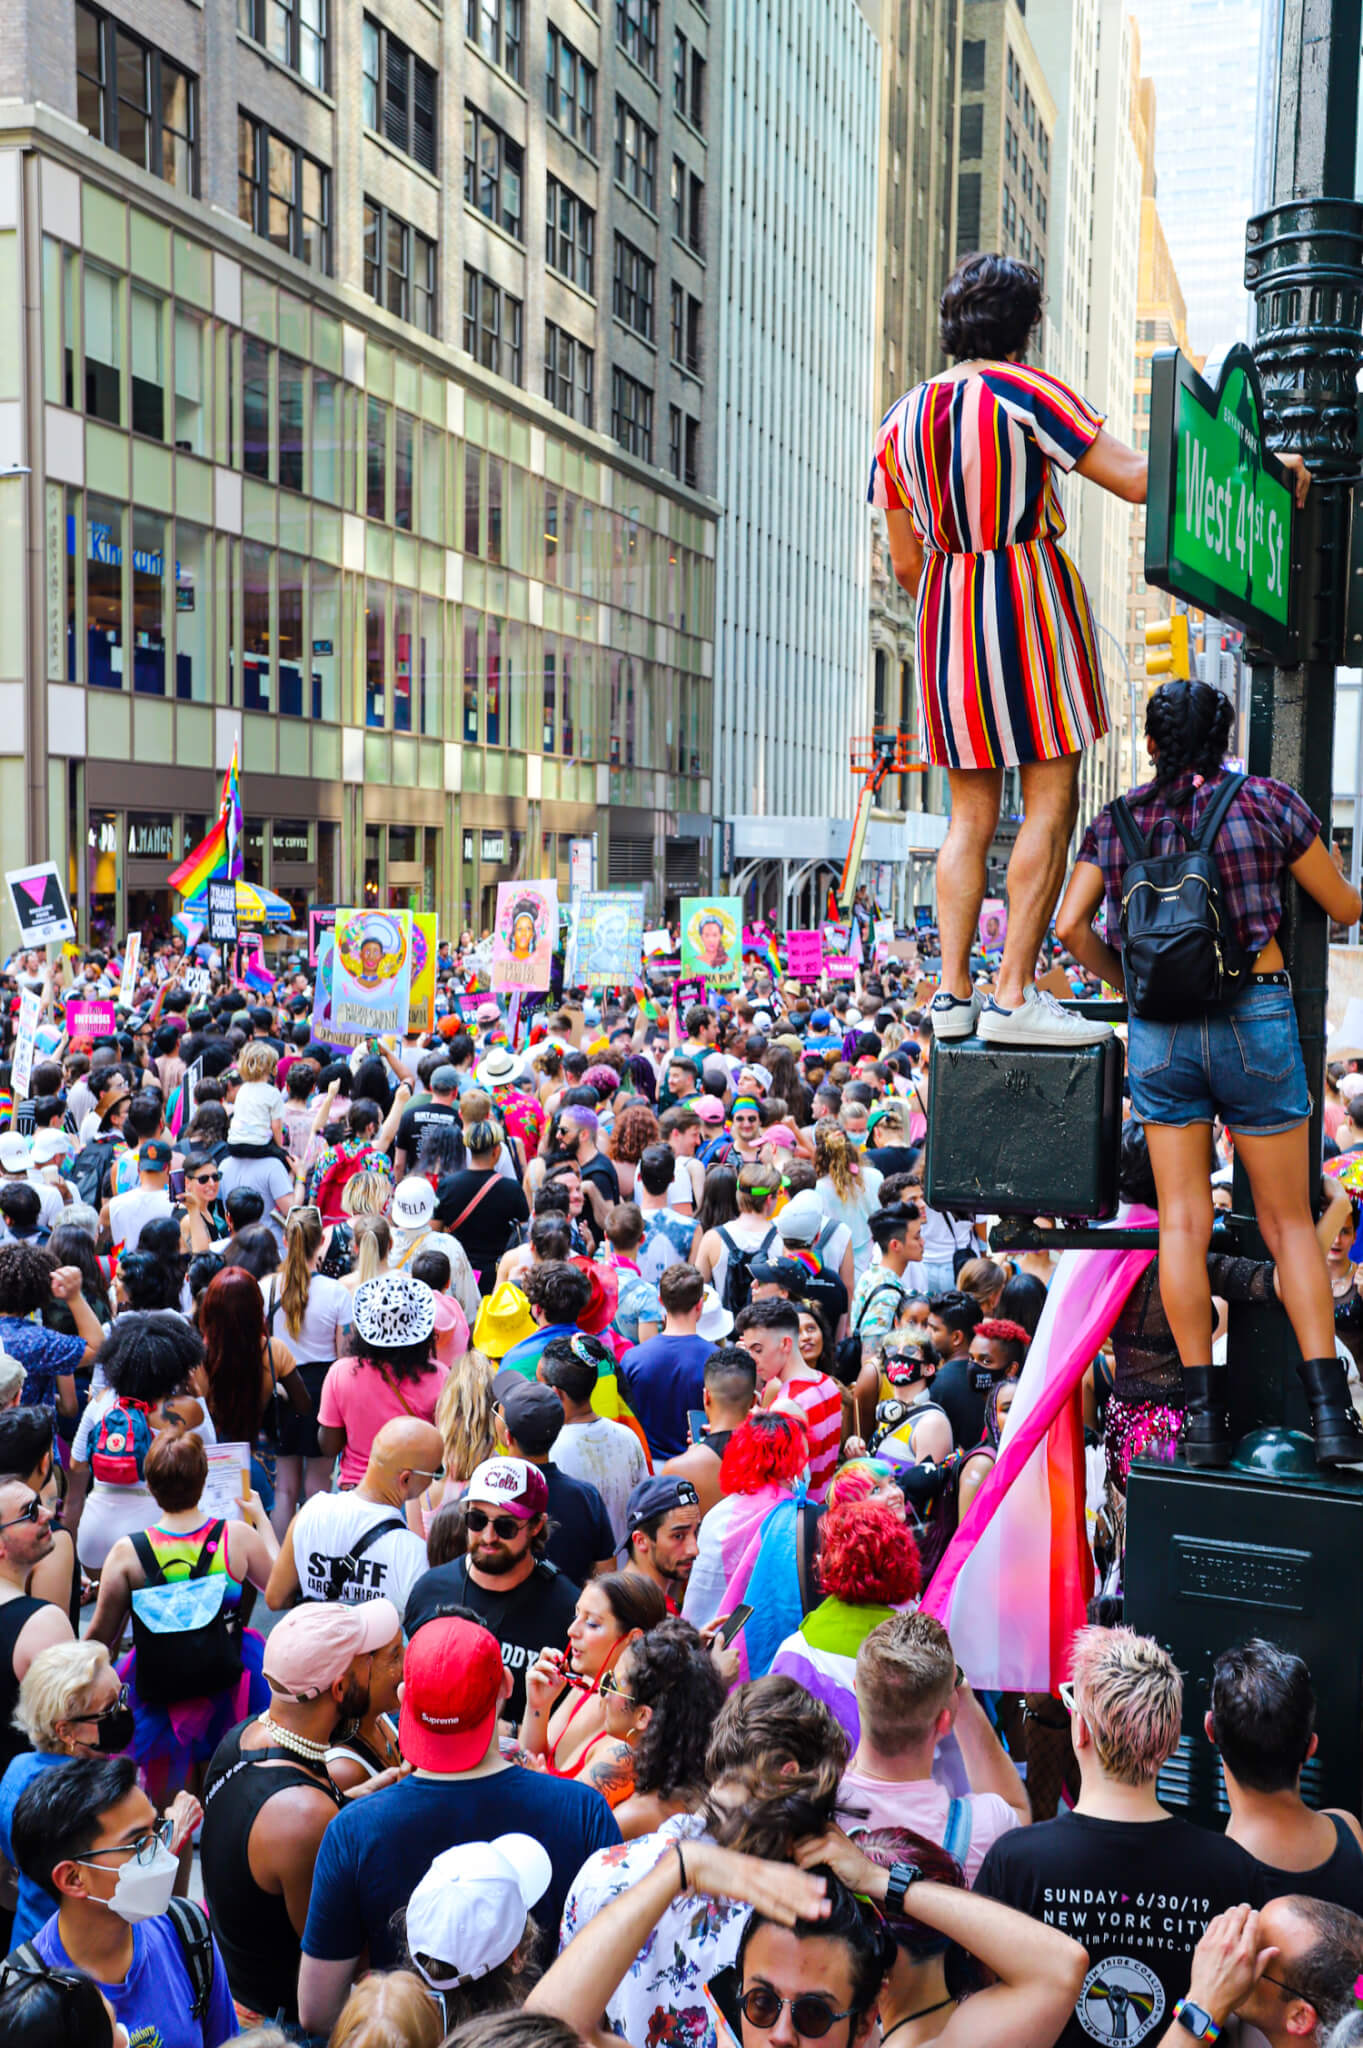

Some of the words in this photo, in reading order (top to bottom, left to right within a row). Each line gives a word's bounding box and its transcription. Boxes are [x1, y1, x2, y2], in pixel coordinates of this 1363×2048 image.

[1224, 406, 1244, 440] BRYANT
[1244, 427, 1258, 455] PARK
[1185, 430, 1231, 562] West
[1236, 483, 1264, 577] 41st
[1267, 508, 1284, 598] St
[128, 825, 136, 852] A
[138, 826, 173, 852] MANGE
[210, 884, 235, 898] TRANS
[210, 899, 236, 912] POWER
[212, 926, 237, 938] POWER
[308, 1552, 388, 1588] STFF
[502, 1642, 541, 1673] DDY
[422, 1712, 459, 1726] Supreme
[1044, 1888, 1118, 1905] SUNDAY
[1136, 1892, 1210, 1913] 6/30/19
[1044, 1910, 1087, 1927] NEW
[1097, 1911, 1152, 1930] YORK
[1163, 1917, 1209, 1935] CITY
[1101, 1958, 1130, 1970] PRIDE
[1134, 1963, 1164, 2012] COALITION
[1083, 2019, 1100, 2037] NEW
[1106, 2037, 1136, 2047] YORK
[1137, 2020, 1154, 2038] CITY
